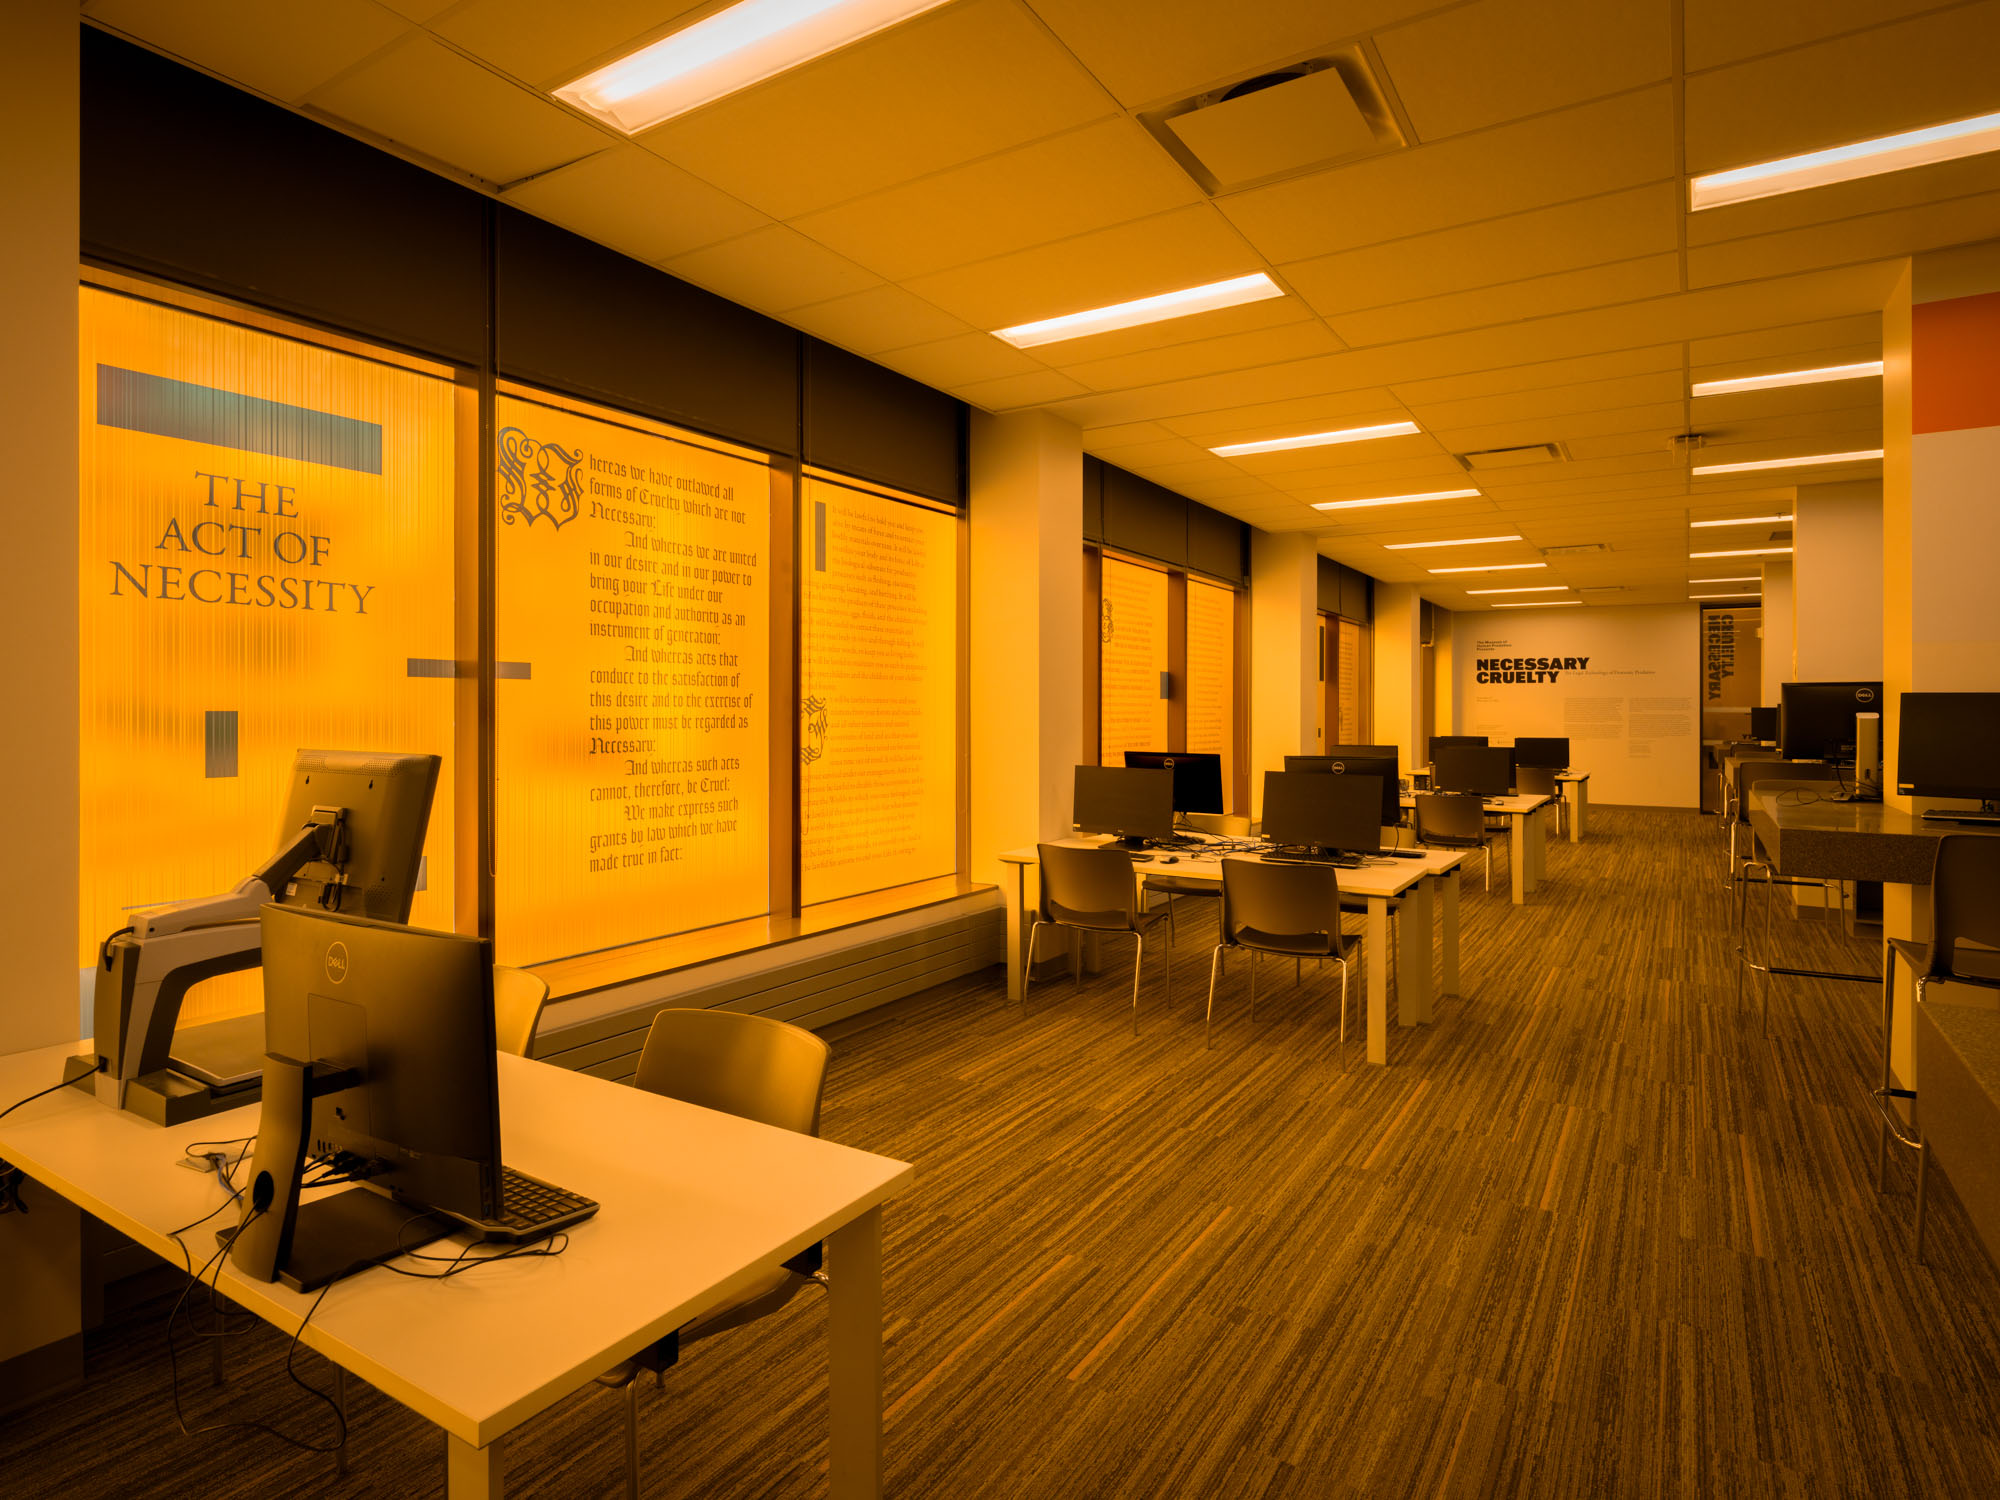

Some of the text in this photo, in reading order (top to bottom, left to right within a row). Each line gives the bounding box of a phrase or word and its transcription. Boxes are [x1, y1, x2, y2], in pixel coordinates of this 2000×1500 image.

[195, 470, 299, 518] THE
[630, 466, 646, 482] we
[650, 468, 672, 487] have
[676, 475, 720, 498] outlawed
[723, 487, 734, 501] all
[590, 477, 746, 524] forms of Cruelty which are not
[590, 501, 656, 532] Necessary:
[154, 517, 331, 567] ACT OF
[625, 531, 757, 567] And whereas we are united
[590, 551, 752, 586] in our desire and in our power to
[109, 560, 375, 614] NECESSITY
[590, 573, 723, 603] bring your Life under our
[590, 599, 745, 628] occupation and authority as an
[590, 622, 720, 645] instrument of generation:
[625, 646, 738, 666] And whereas acts that
[1477, 657, 1590, 670] NECESSARY
[638, 670, 648, 684] to
[652, 670, 668, 685] the
[672, 672, 728, 687] satisfaction
[731, 673, 740, 688] of
[1476, 671, 1560, 684] CRUELTY
[590, 692, 753, 708] this desire and to the exercise of
[590, 714, 748, 733] this power must be regarded as
[590, 738, 656, 756] Necessary:
[624, 757, 740, 776] And whereas such acts
[590, 778, 730, 802] cannot, therefore, be Cruel:
[624, 798, 738, 820] We make express such
[590, 819, 737, 853] grants by law which we have
[590, 847, 682, 872] made true in fact:
